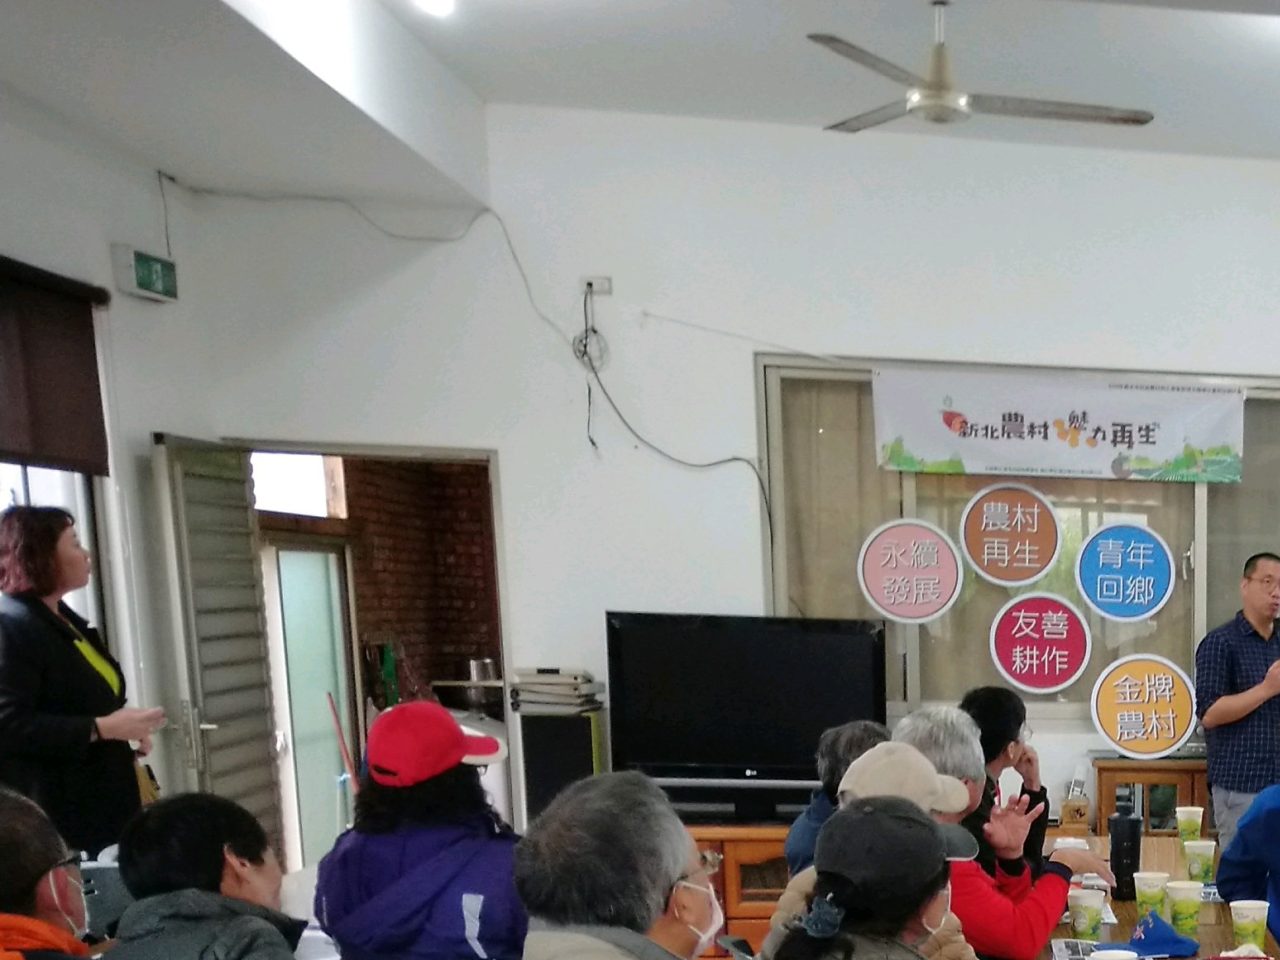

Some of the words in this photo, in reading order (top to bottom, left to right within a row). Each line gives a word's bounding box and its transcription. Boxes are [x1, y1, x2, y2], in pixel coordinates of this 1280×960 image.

[981, 502, 1041, 533] 農村
[879, 539, 939, 569] 永續
[981, 538, 1041, 568] 再生
[1096, 539, 1154, 570] 青年
[882, 575, 942, 605] 發展
[1096, 575, 1154, 605] 回鄉
[1011, 609, 1069, 640] 友善
[1011, 645, 1069, 675] 耕作
[1113, 672, 1175, 704] 金牌
[1116, 708, 1177, 742] 農村
